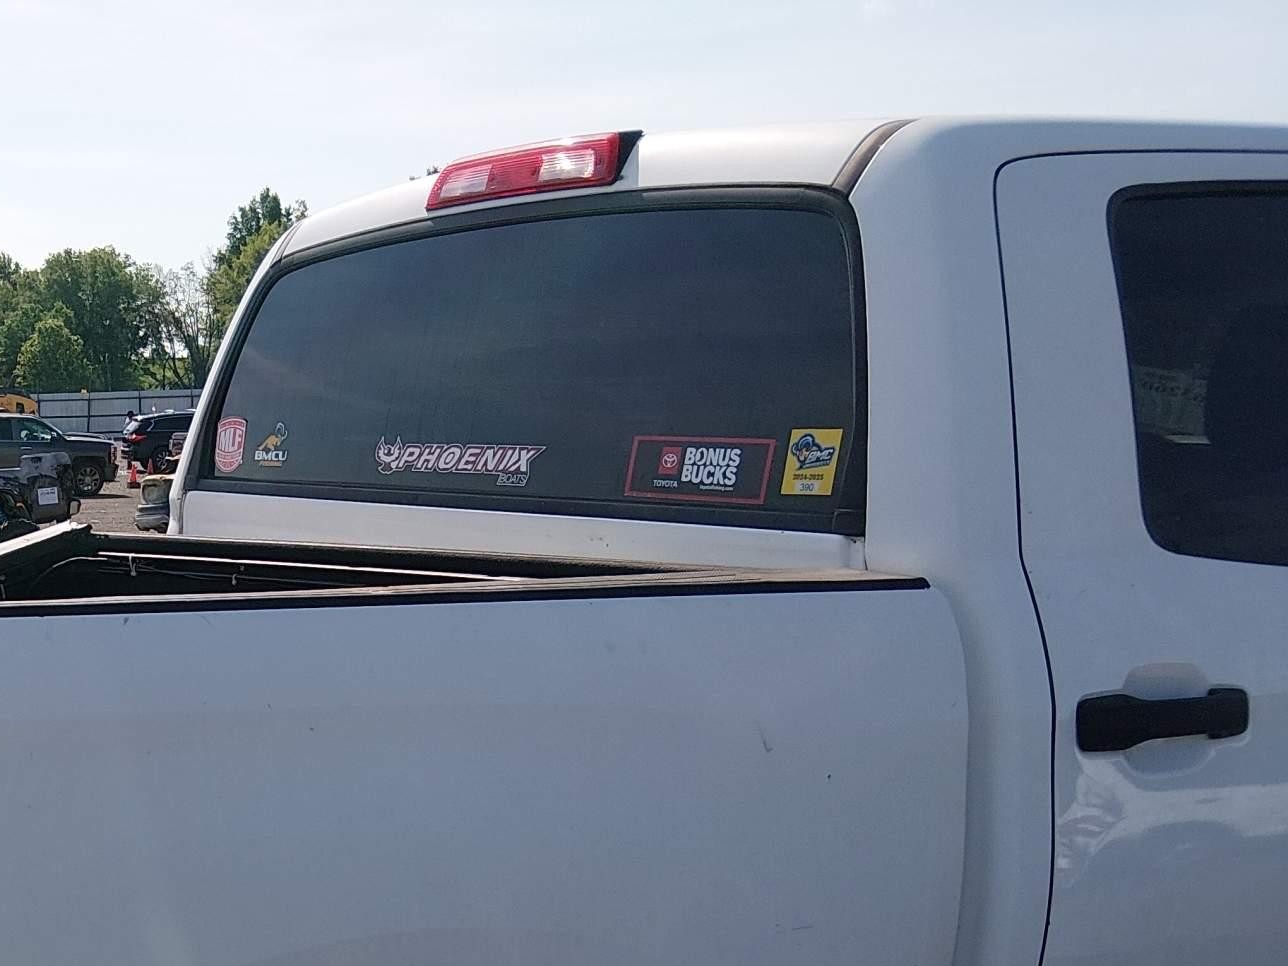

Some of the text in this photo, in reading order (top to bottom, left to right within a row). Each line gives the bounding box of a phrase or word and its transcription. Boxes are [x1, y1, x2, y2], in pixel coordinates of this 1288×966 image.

[219, 427, 242, 453] MLF
[254, 450, 288, 461] BMCU
[398, 444, 546, 474] PHOENIX
[684, 447, 742, 467] BONUS
[499, 474, 527, 485] BOATS
[680, 465, 737, 486] BUCKS
[653, 479, 678, 488] TOYOTA
[799, 483, 815, 491] 390
